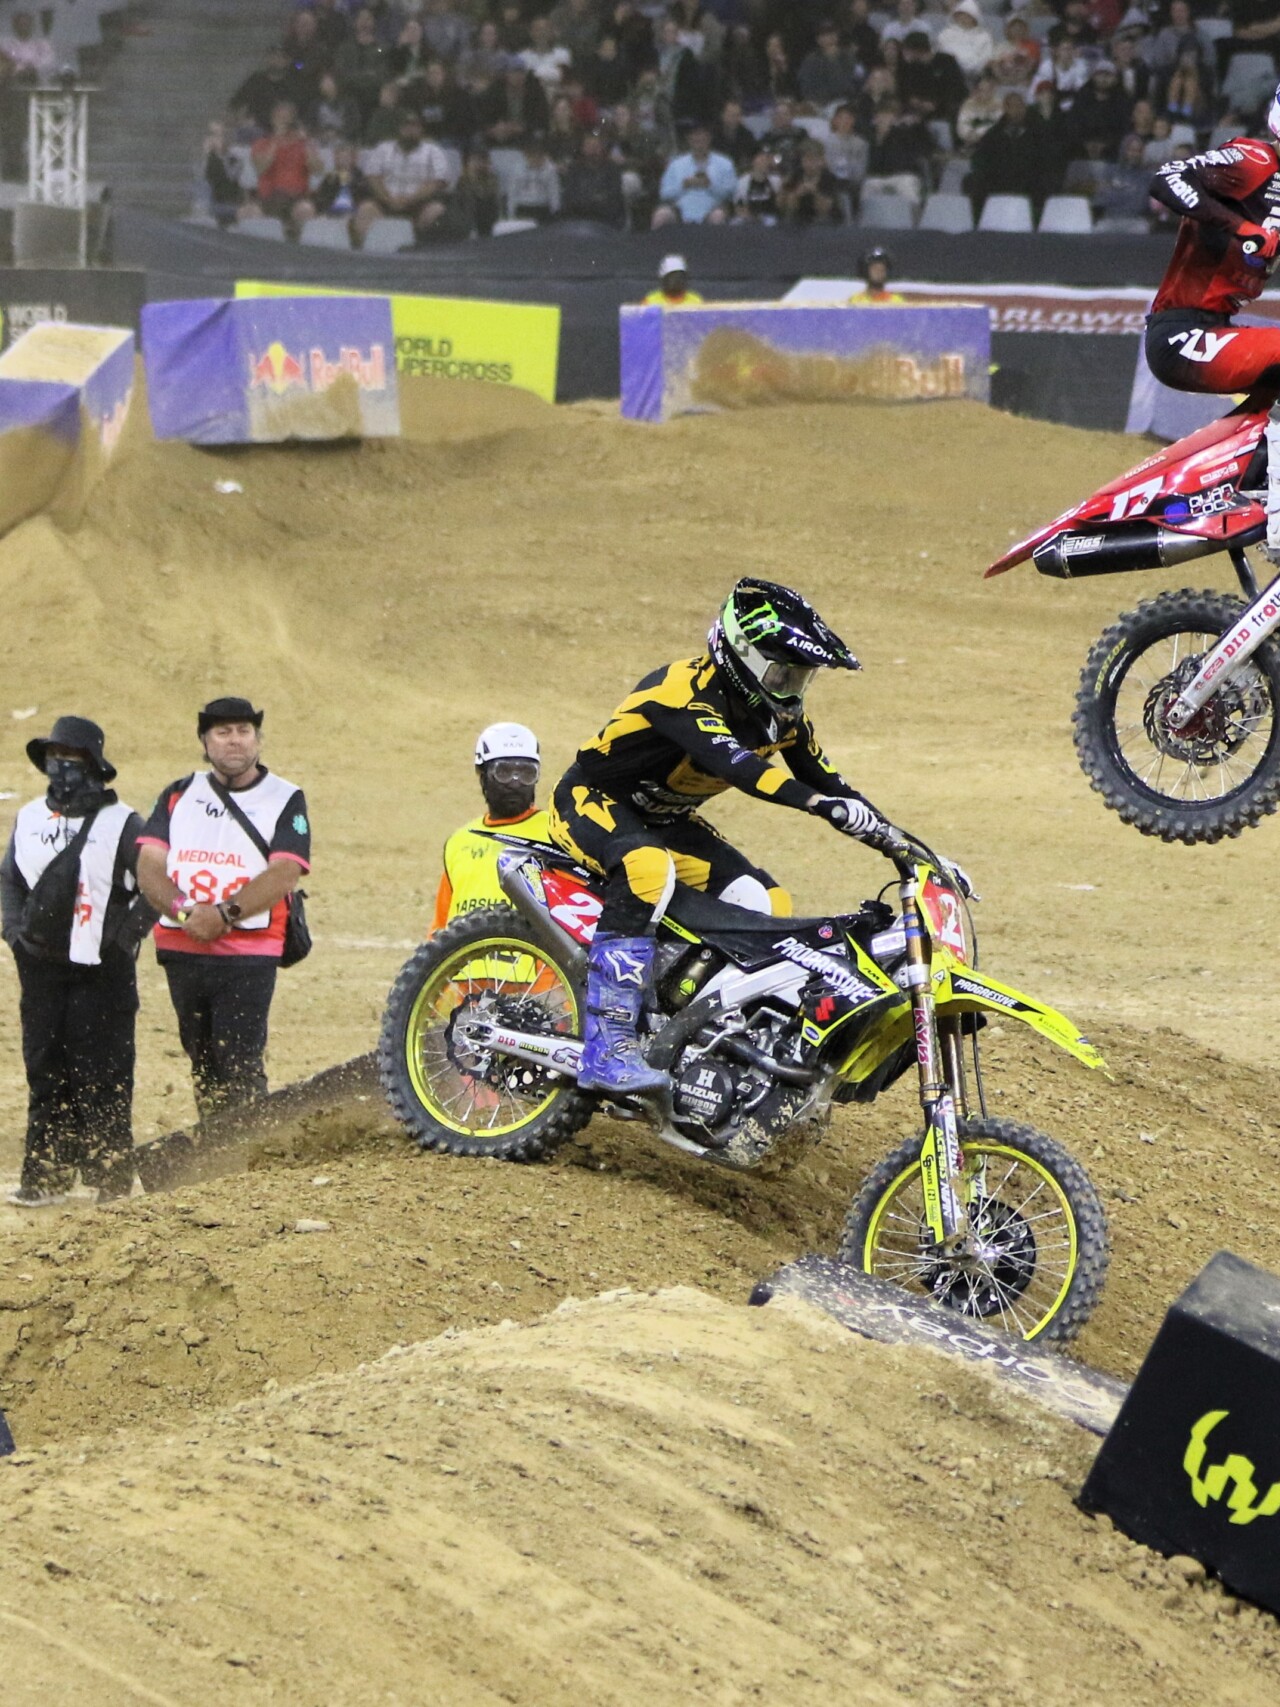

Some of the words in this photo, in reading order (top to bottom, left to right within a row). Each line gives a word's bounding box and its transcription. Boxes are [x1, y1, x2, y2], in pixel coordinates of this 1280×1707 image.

[396, 357, 513, 383] UPERCROSS
[1124, 455, 1167, 479] HONDA
[1110, 475, 1164, 521] 17
[1223, 628, 1251, 658] DID
[1094, 638, 1127, 694] DUNLOP
[177, 849, 246, 868] MEDICAL
[772, 936, 874, 1004] PROGRESSIVE
[954, 978, 1019, 1009] PROGRESSIVE
[497, 1035, 516, 1047] DID
[914, 1008, 930, 1064] KYB
[680, 1083, 723, 1103] SUZUKI
